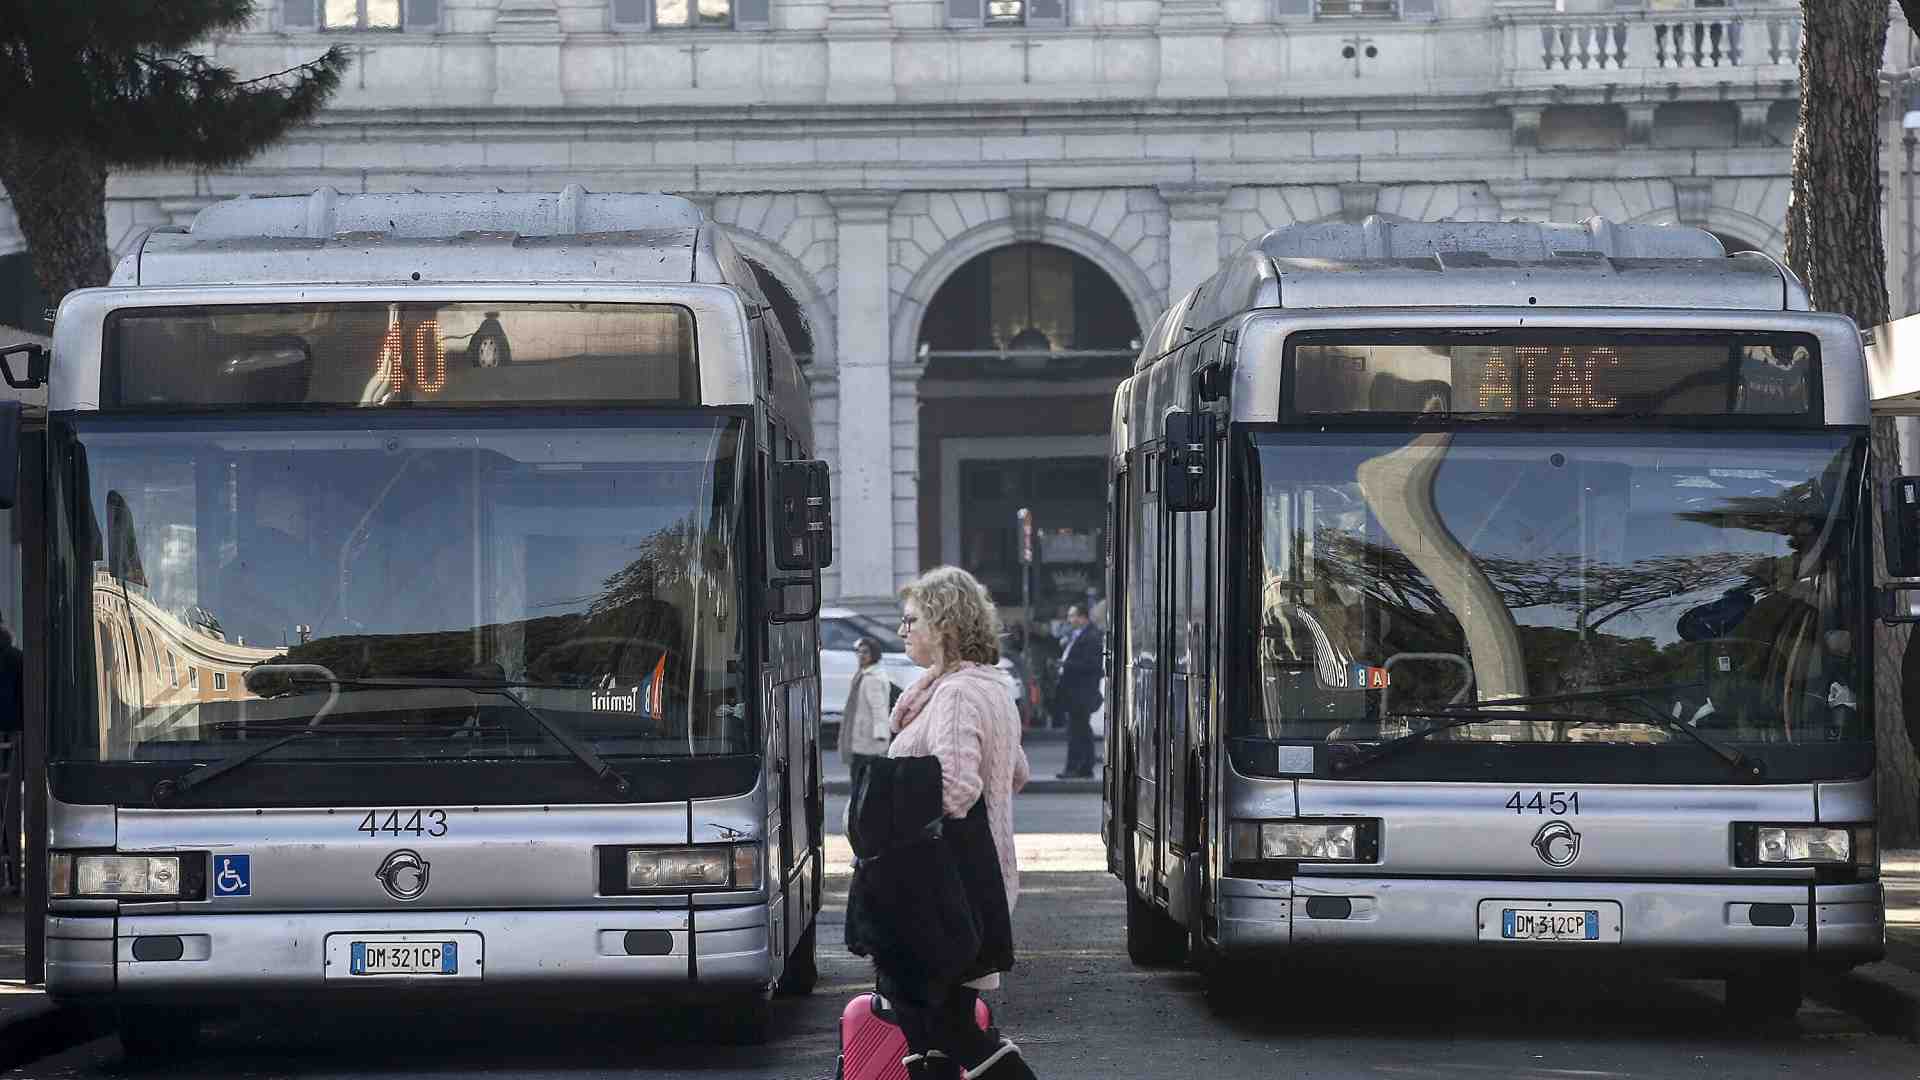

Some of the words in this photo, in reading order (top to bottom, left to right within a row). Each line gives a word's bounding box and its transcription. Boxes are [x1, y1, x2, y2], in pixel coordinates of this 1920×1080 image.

[1479, 347, 1619, 408] ATAC
[1505, 791, 1579, 815] 4451
[358, 808, 448, 837] 4443
